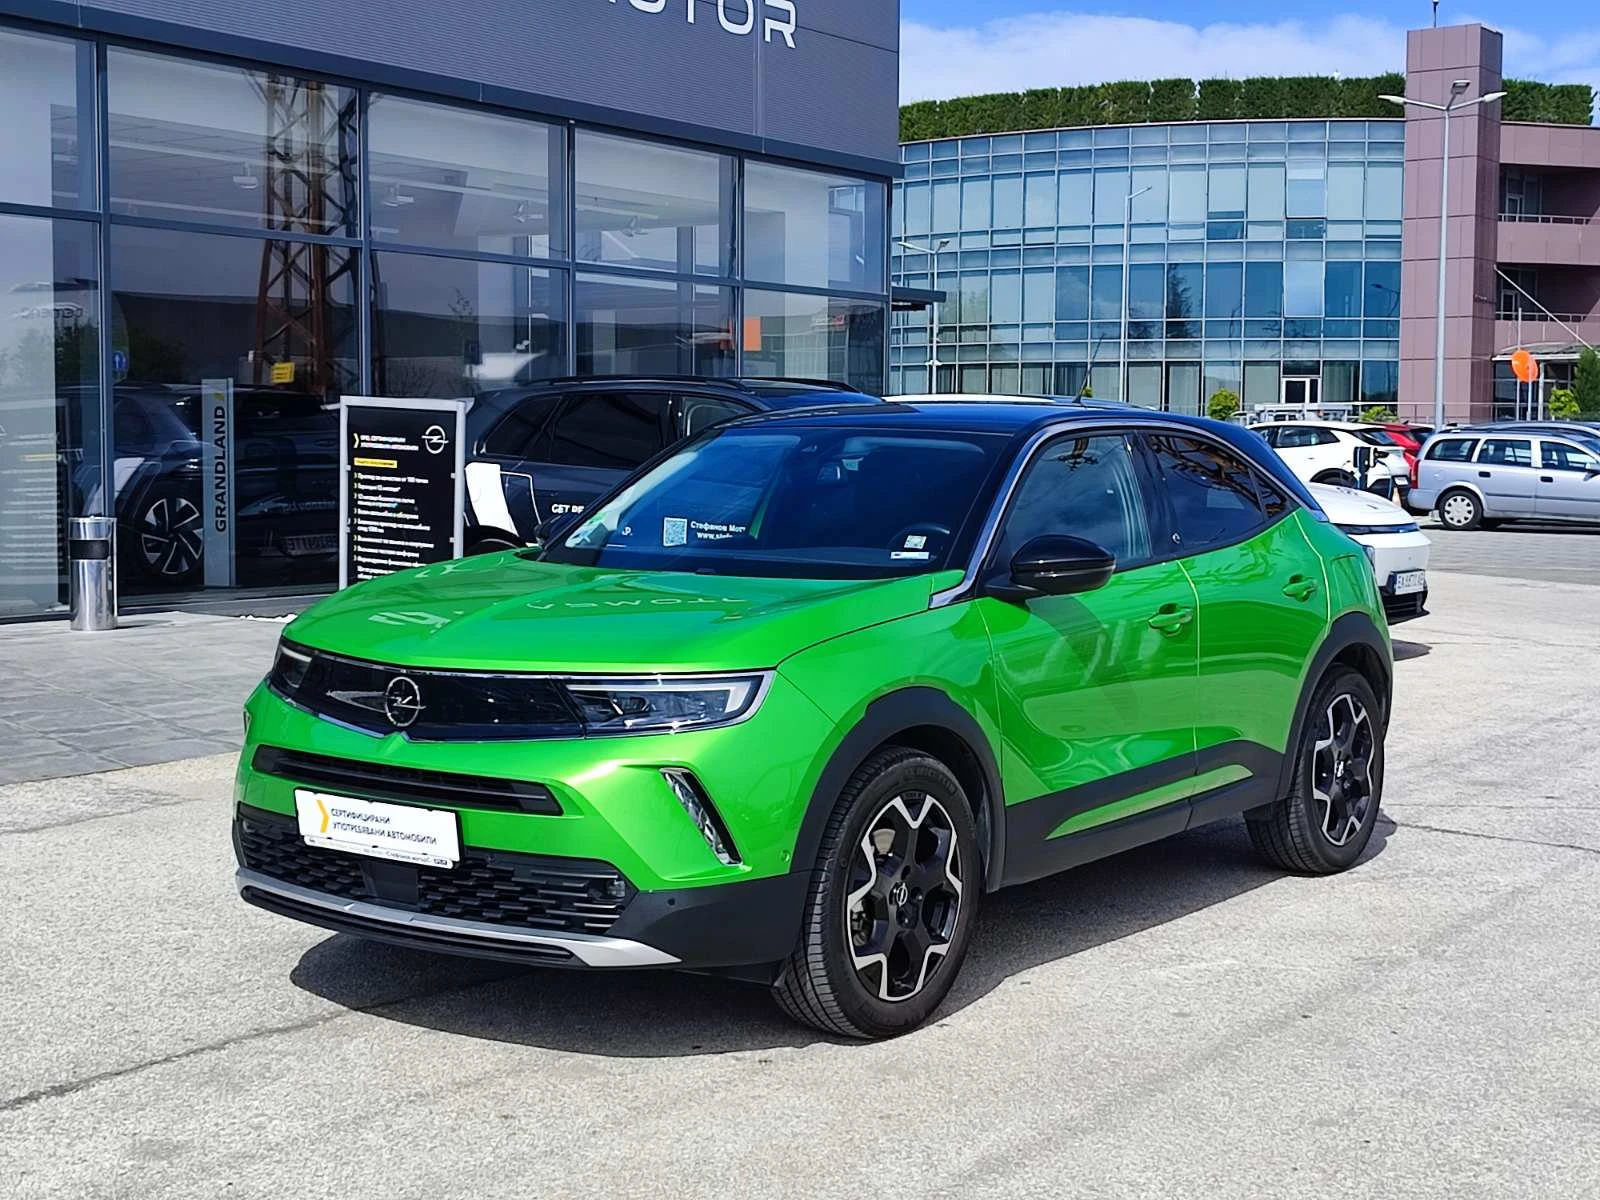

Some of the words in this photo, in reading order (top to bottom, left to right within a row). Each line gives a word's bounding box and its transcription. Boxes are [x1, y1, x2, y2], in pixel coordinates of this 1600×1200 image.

[213, 405, 227, 533] GRANDLAND
[551, 503, 570, 514] GET
[330, 808, 391, 825] СЕРТИФИЦИРАНИ
[386, 831, 438, 846] АВТОМОБИЛИ
